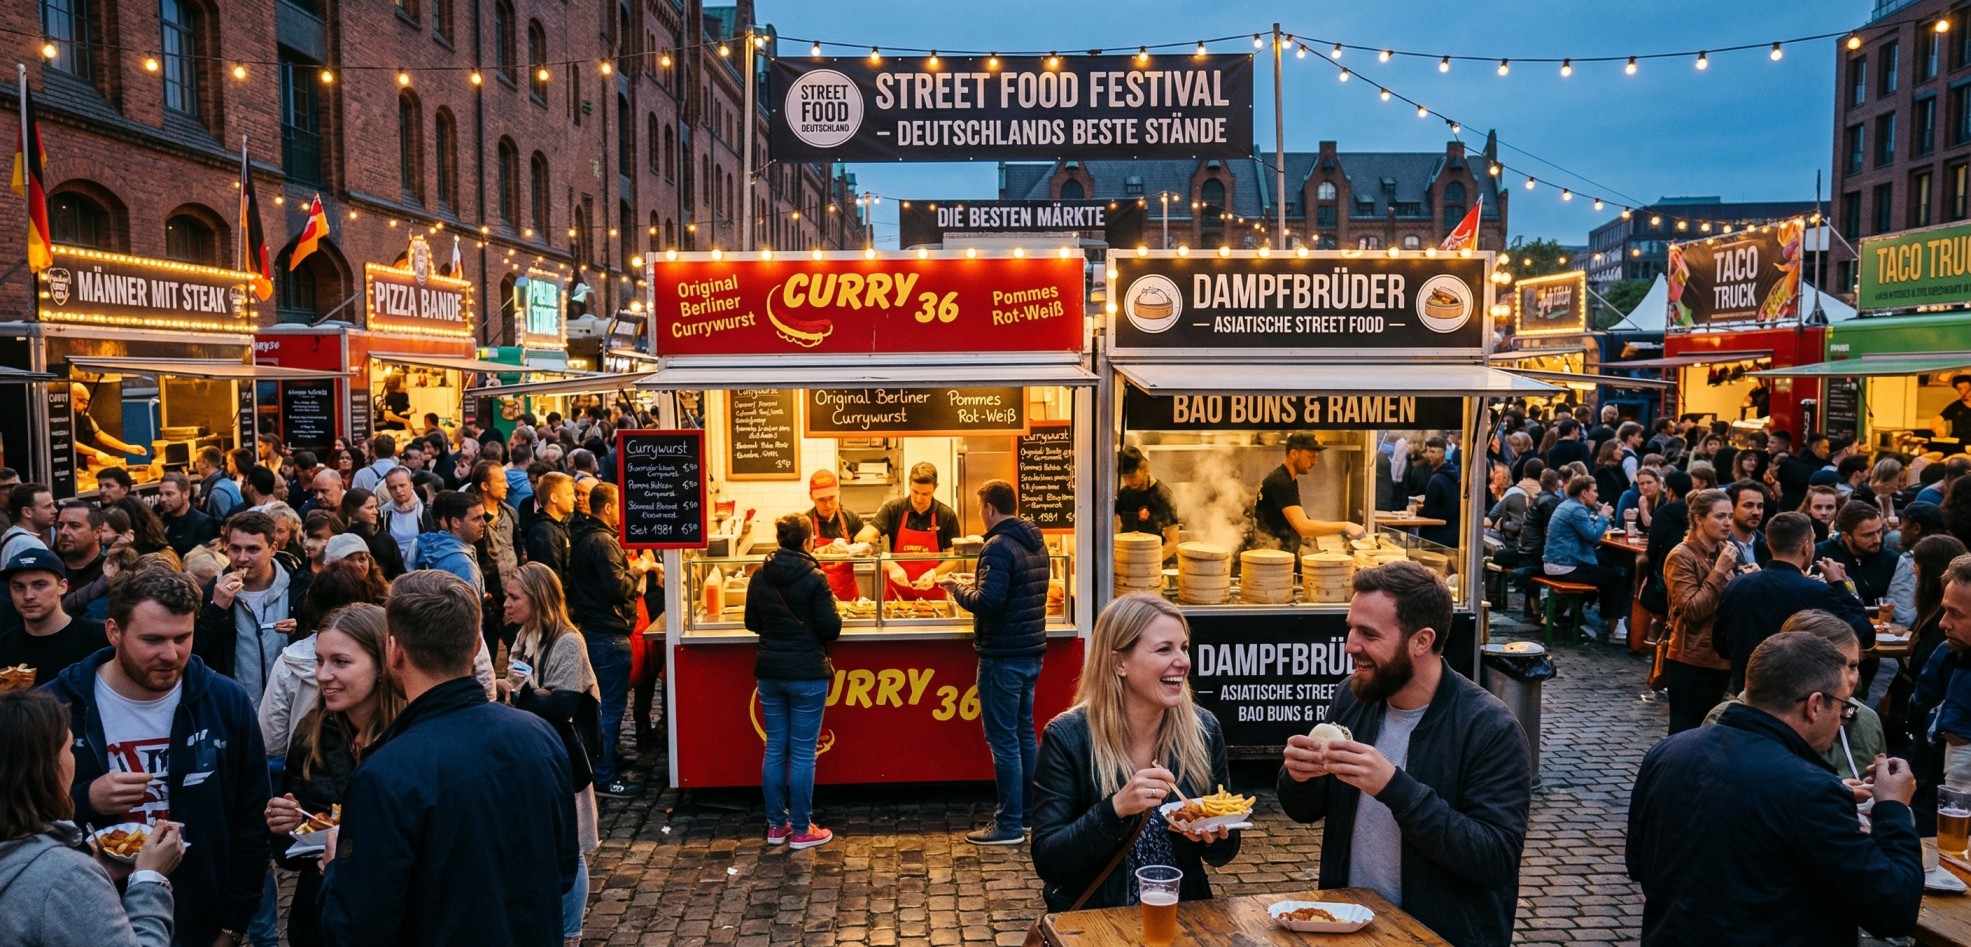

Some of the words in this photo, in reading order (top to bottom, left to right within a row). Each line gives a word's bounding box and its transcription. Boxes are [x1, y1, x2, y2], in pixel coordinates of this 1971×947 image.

[800, 84, 849, 100] STREET
[875, 72, 991, 110] STREET
[1000, 71, 1079, 109] FOOD
[1089, 70, 1230, 108] FESTIVAL
[801, 101, 849, 122] FOOD
[801, 123, 850, 133] DEUTSCHLAND
[897, 119, 1066, 146] DEUTSCHLANDS
[1072, 118, 1139, 145] BESTE
[1144, 112, 1227, 144] STÄNDE
[937, 207, 964, 228] DIE
[969, 206, 1032, 228] BESTEN
[1036, 202, 1106, 227] MÄRKTE
[1713, 245, 1759, 284] TACO
[1876, 242, 1923, 284] TACO
[77, 265, 148, 308] MÄNNER
[151, 279, 179, 310] MIT
[182, 283, 227, 314] STEAK
[677, 273, 739, 299] Original
[783, 272, 920, 310] CURRY
[914, 291, 960, 324] 36
[992, 285, 1059, 306] Pommes
[1193, 267, 1406, 310] DAMPFBRÜDER
[1713, 282, 1757, 310] TRUCK
[375, 281, 418, 318] PIZZA
[420, 288, 463, 323] BANDE
[680, 296, 741, 318] Berliner
[992, 300, 1065, 326] Rot-Weiß
[671, 310, 757, 338] Currywurst
[1213, 315, 1293, 334] ASIATISCHE
[1295, 315, 1346, 334] STREET
[1349, 315, 1384, 333] FOOD
[815, 389, 871, 412] Original
[875, 388, 931, 405] Berliner
[947, 389, 1001, 406] Pommes
[1173, 395, 1223, 423] BAO
[1230, 395, 1297, 423] BUNS
[1303, 395, 1321, 423] &
[1327, 395, 1416, 423] RAMEN
[831, 407, 908, 430] Currywurst
[957, 408, 1017, 425] Rot-Weiß
[626, 440, 689, 460] Currywurst
[651, 524, 673, 535] 1981
[826, 668, 936, 709] URRY
[932, 685, 982, 721] 36
[1220, 684, 1293, 700] ASIATISCHE
[1296, 684, 1339, 700] STREE
[1238, 705, 1265, 722] BAO
[1267, 705, 1301, 722] BUNS
[1304, 705, 1313, 721] &
